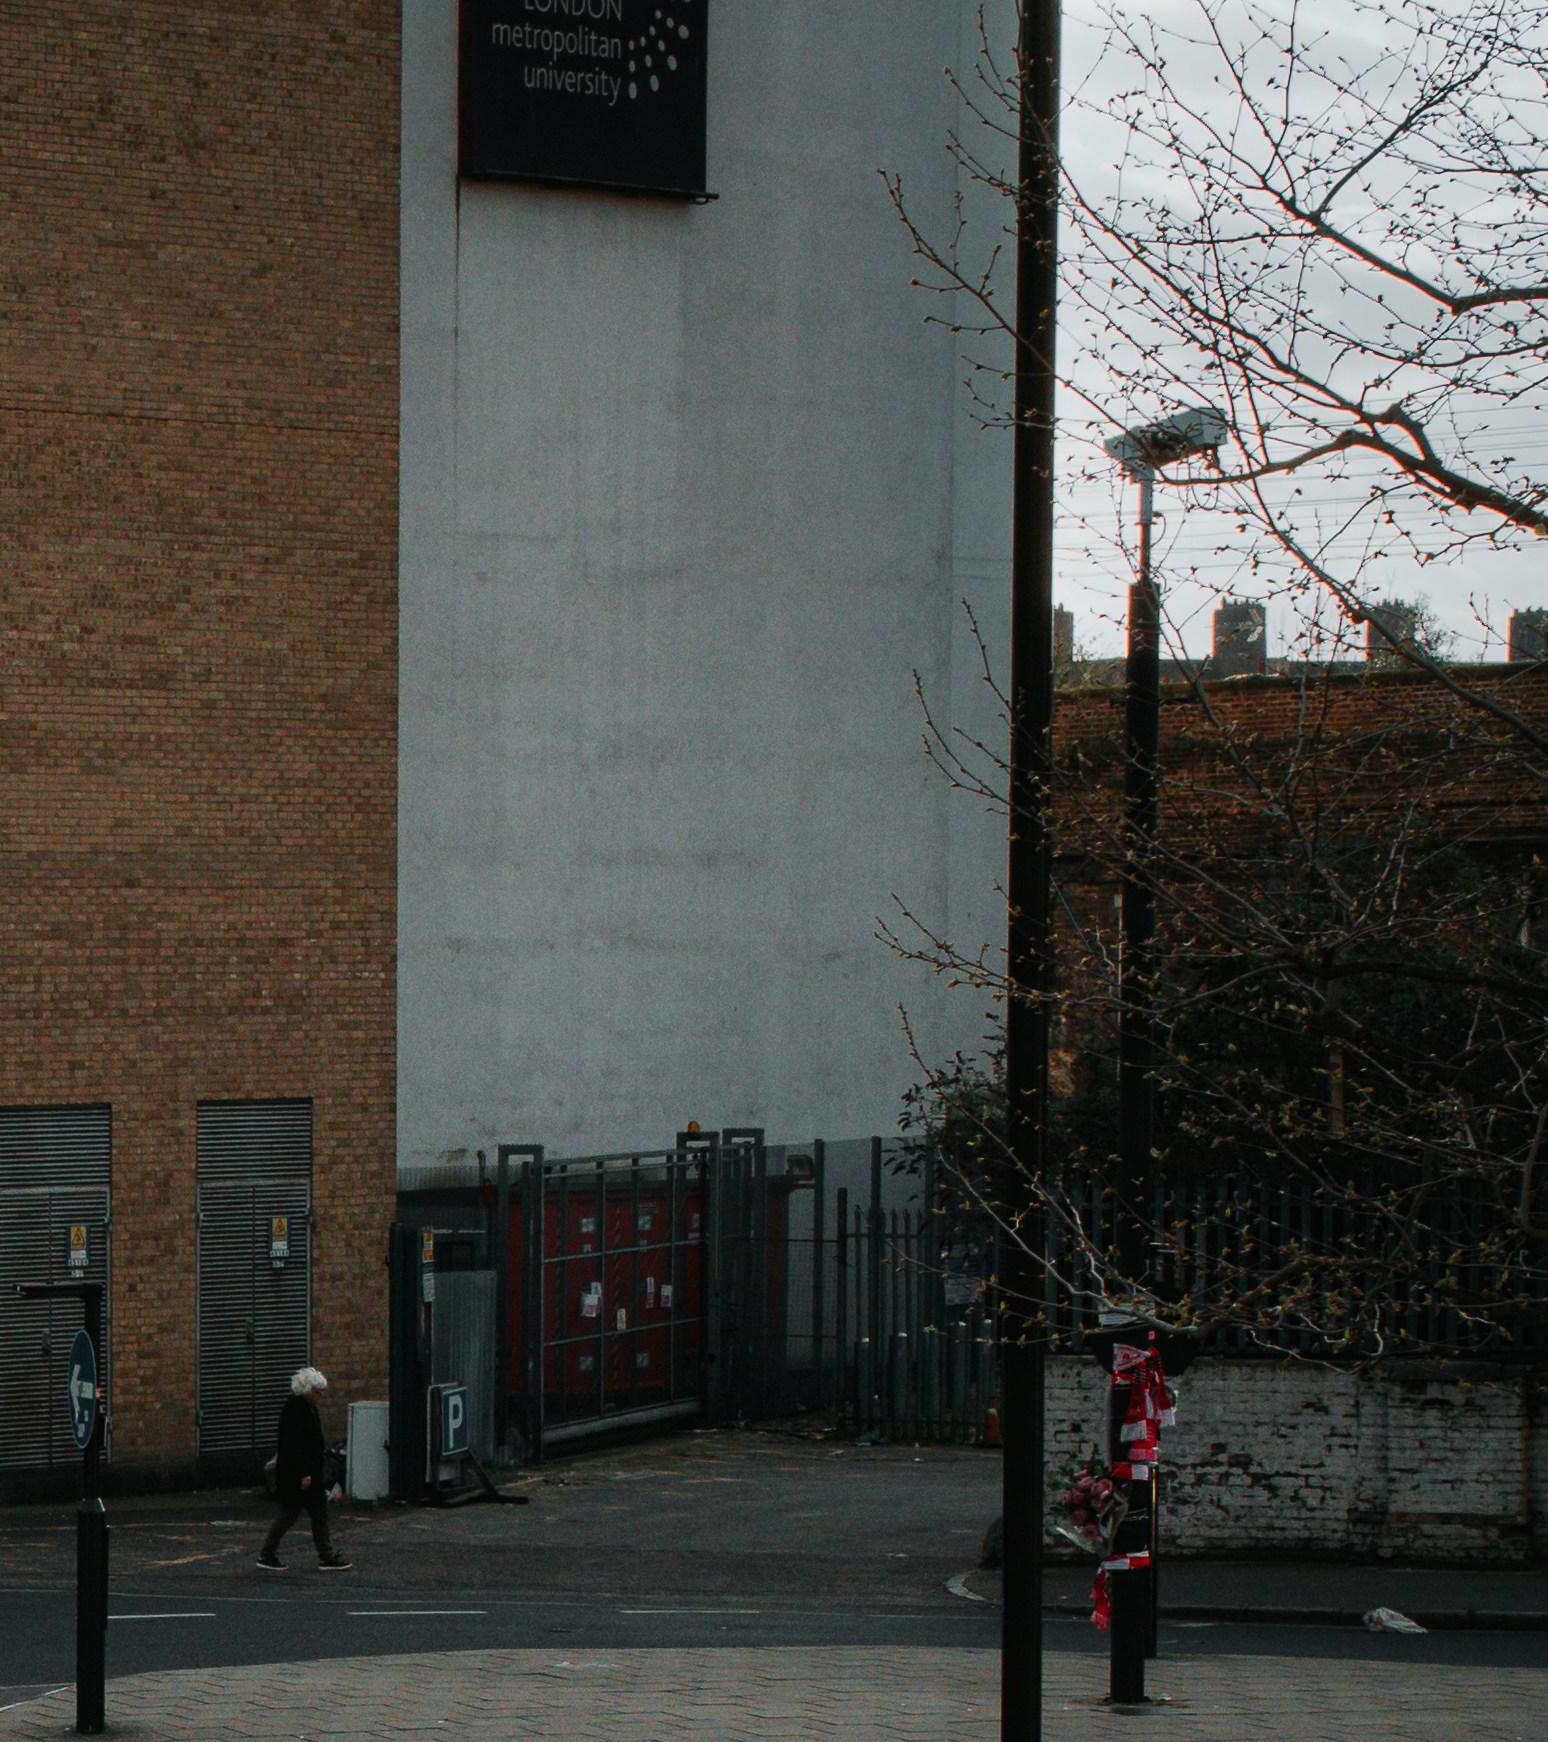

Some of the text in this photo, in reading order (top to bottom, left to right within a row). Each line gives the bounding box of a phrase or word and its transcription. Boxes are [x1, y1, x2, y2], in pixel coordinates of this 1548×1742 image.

[492, 22, 622, 61] metropolitan
[524, 61, 622, 106] university
[448, 1393, 464, 1449] P
